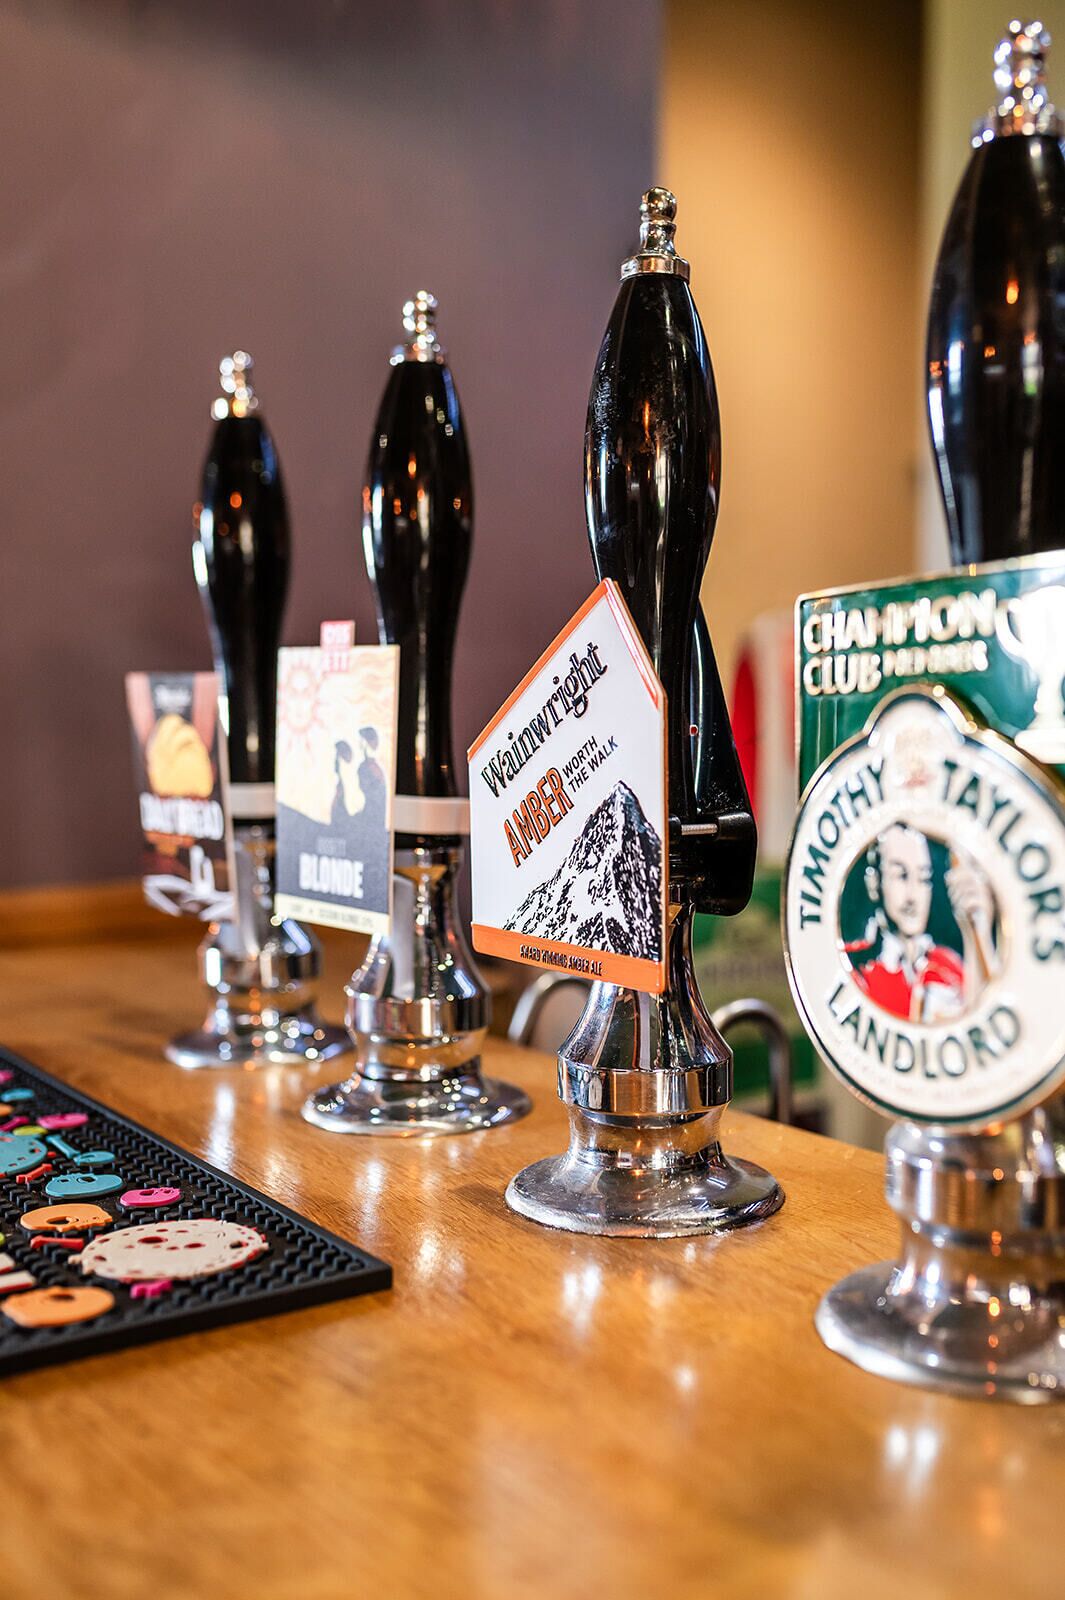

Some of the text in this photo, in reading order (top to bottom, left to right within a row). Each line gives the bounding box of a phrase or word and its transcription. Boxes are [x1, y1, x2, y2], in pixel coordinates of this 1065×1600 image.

[803, 653, 882, 696] CLUB
[480, 641, 608, 798] Wainwright
[562, 735, 598, 779] WORTH
[568, 735, 619, 793] THE WALK
[503, 767, 575, 868] AMBER
[800, 758, 884, 930] TIMOTHY
[299, 851, 365, 899] BLONDE
[568, 955, 590, 974] AMBER
[590, 959, 603, 977] ALE
[827, 980, 1022, 1079] LANDLORD
